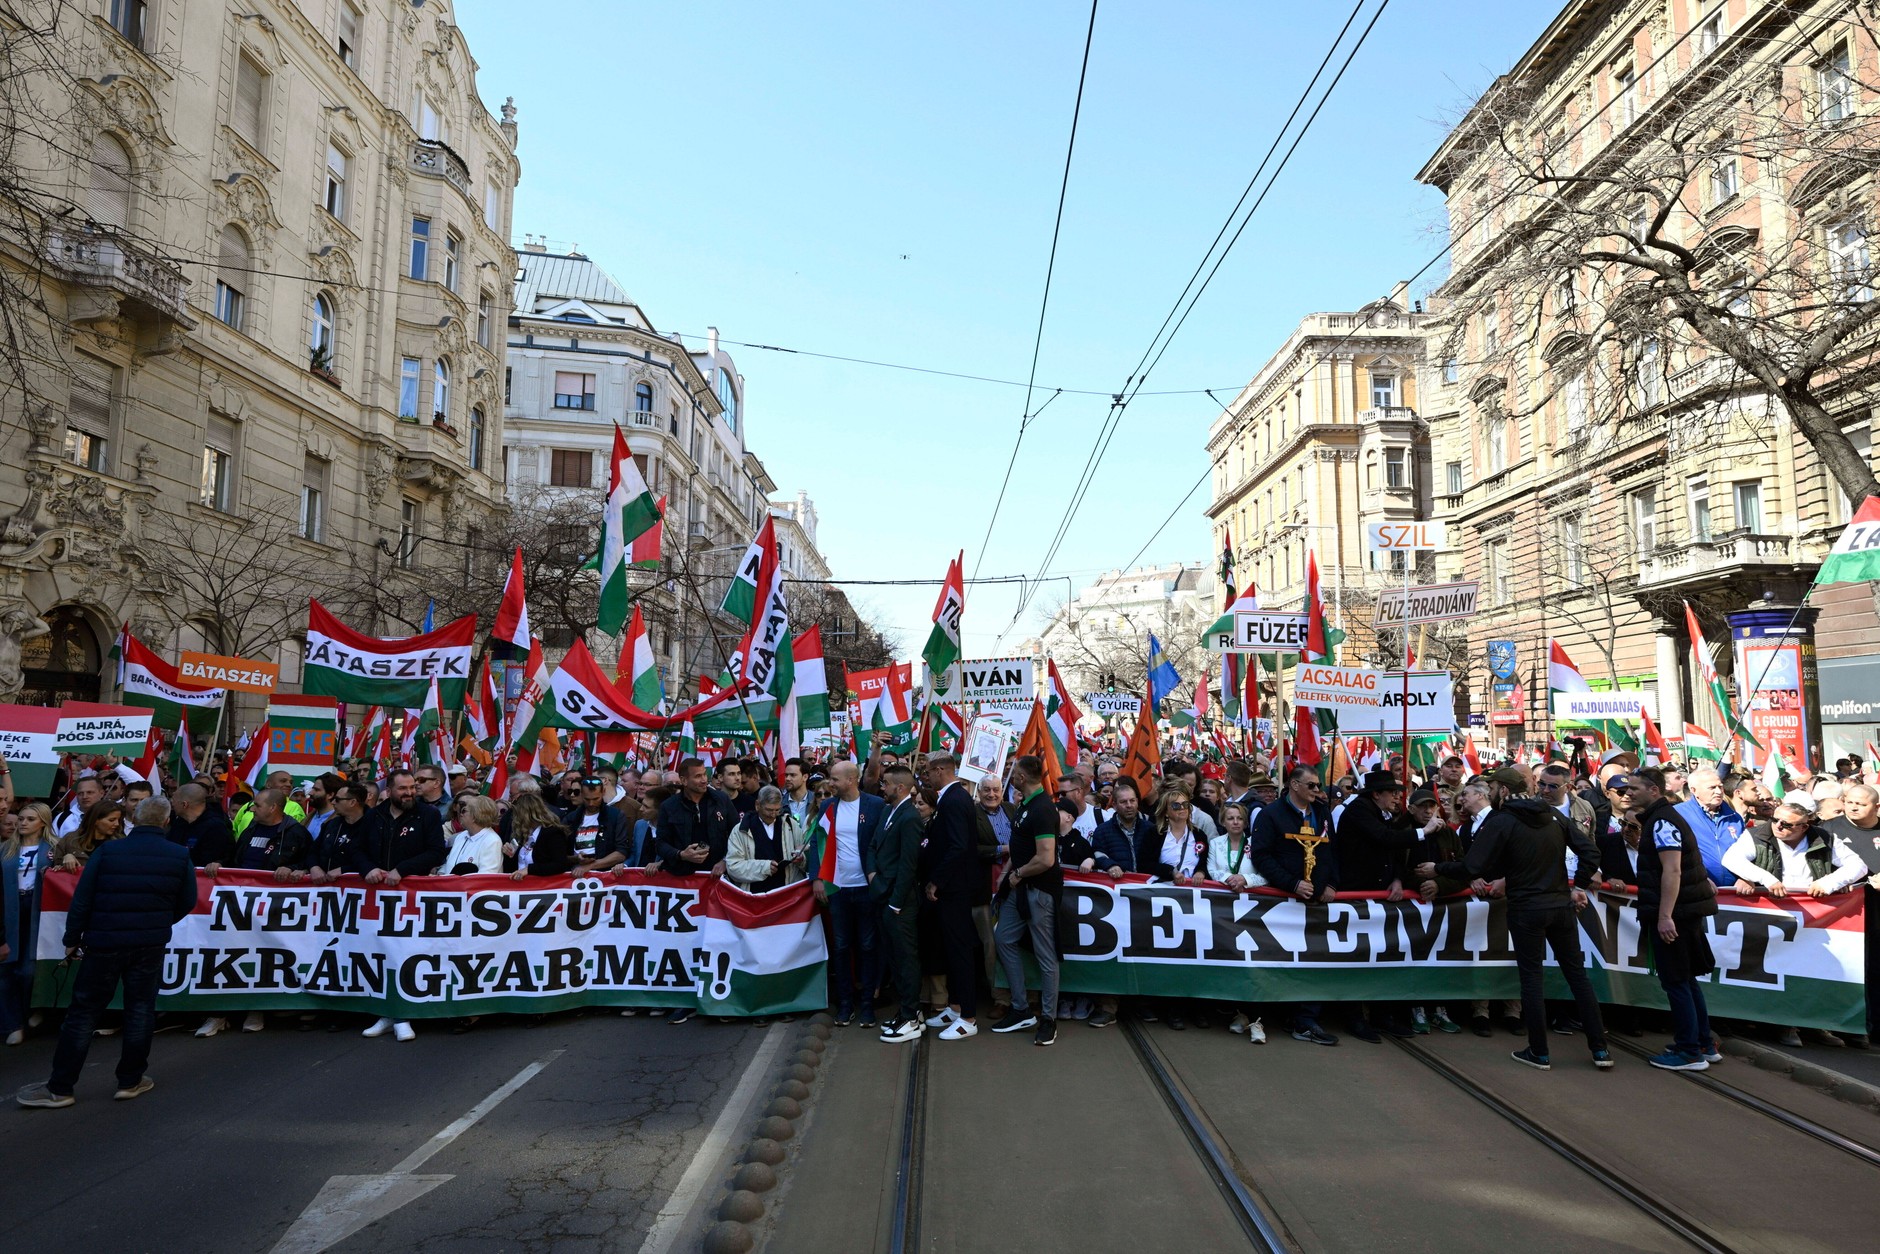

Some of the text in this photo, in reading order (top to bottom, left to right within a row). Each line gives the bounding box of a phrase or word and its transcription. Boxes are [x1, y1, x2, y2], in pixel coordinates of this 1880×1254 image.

[1378, 525, 1435, 548] SZIL
[1379, 588, 1474, 622] FÜZÉRRADVÁNY
[181, 662, 274, 688] BÁTASZÉK
[963, 667, 1022, 688] IVÁN
[1302, 668, 1376, 689] ACSALAG
[1379, 690, 1437, 707] ÁROLY
[1820, 699, 1872, 718] mplifon
[76, 718, 126, 731] HAJRÁ,
[1762, 715, 1798, 727] GRUND
[57, 729, 147, 742] PÓCS JÁNOS!
[272, 729, 332, 756] BÉKE
[3, 750, 31, 760] BÁN
[210, 881, 698, 938] NEM LESZÜNK
[160, 937, 386, 994] UKRÁN
